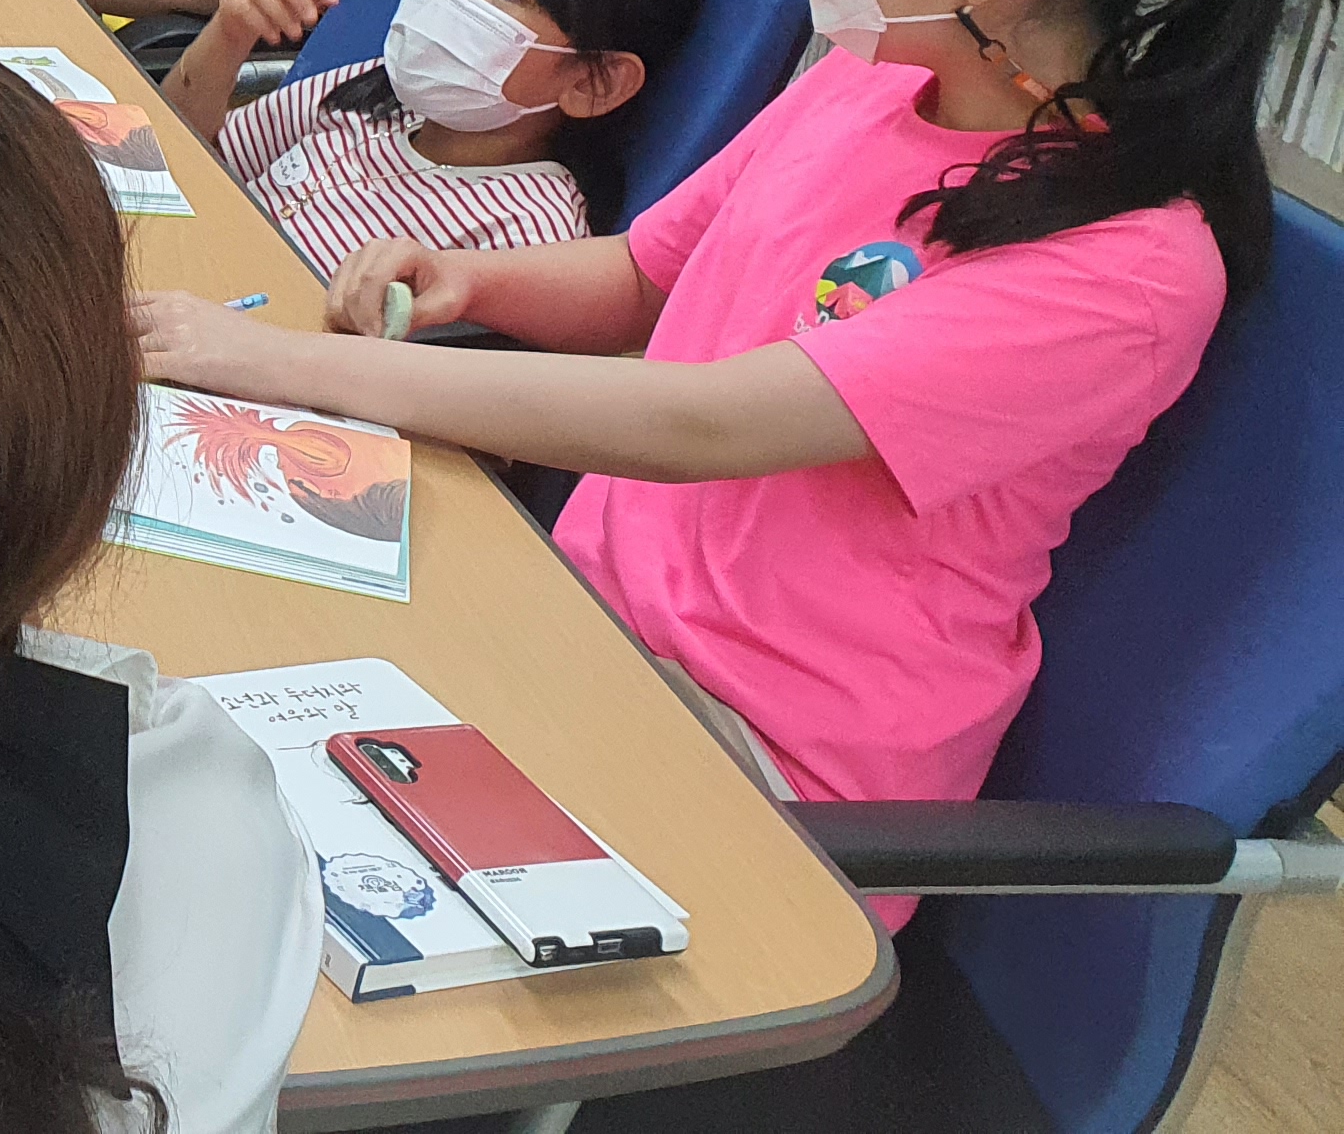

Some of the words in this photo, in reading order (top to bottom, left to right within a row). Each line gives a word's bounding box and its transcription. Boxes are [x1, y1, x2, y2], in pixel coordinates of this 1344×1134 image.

[221, 691, 279, 711] 소년과
[284, 682, 363, 703] 두더지와
[269, 707, 328, 723] 여우와
